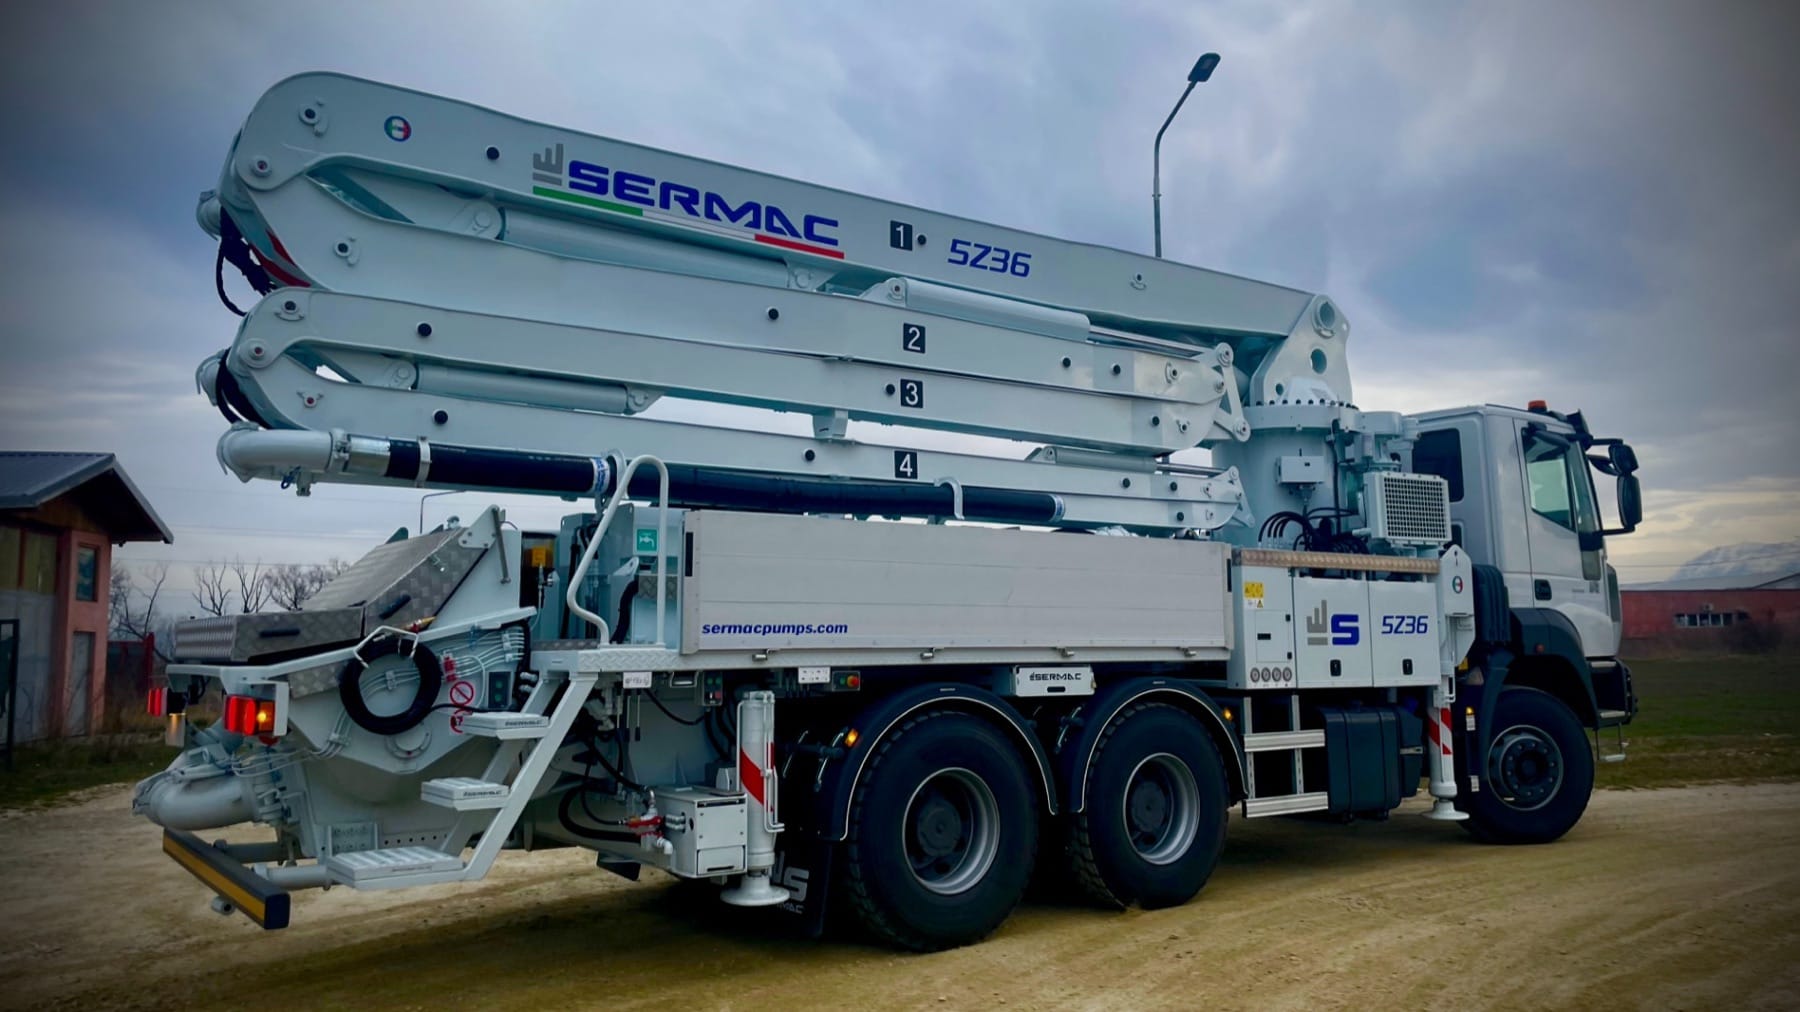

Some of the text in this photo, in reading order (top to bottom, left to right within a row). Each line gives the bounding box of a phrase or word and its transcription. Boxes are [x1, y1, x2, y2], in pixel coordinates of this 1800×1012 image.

[568, 160, 839, 247] SERMAC
[895, 224, 904, 248] 1
[907, 326, 921, 351] 2
[905, 382, 919, 406] 3
[899, 453, 913, 477] 4
[702, 623, 848, 636] sermacpumps.com
[1331, 614, 1360, 645] S
[1035, 672, 1082, 681] SERMAC
